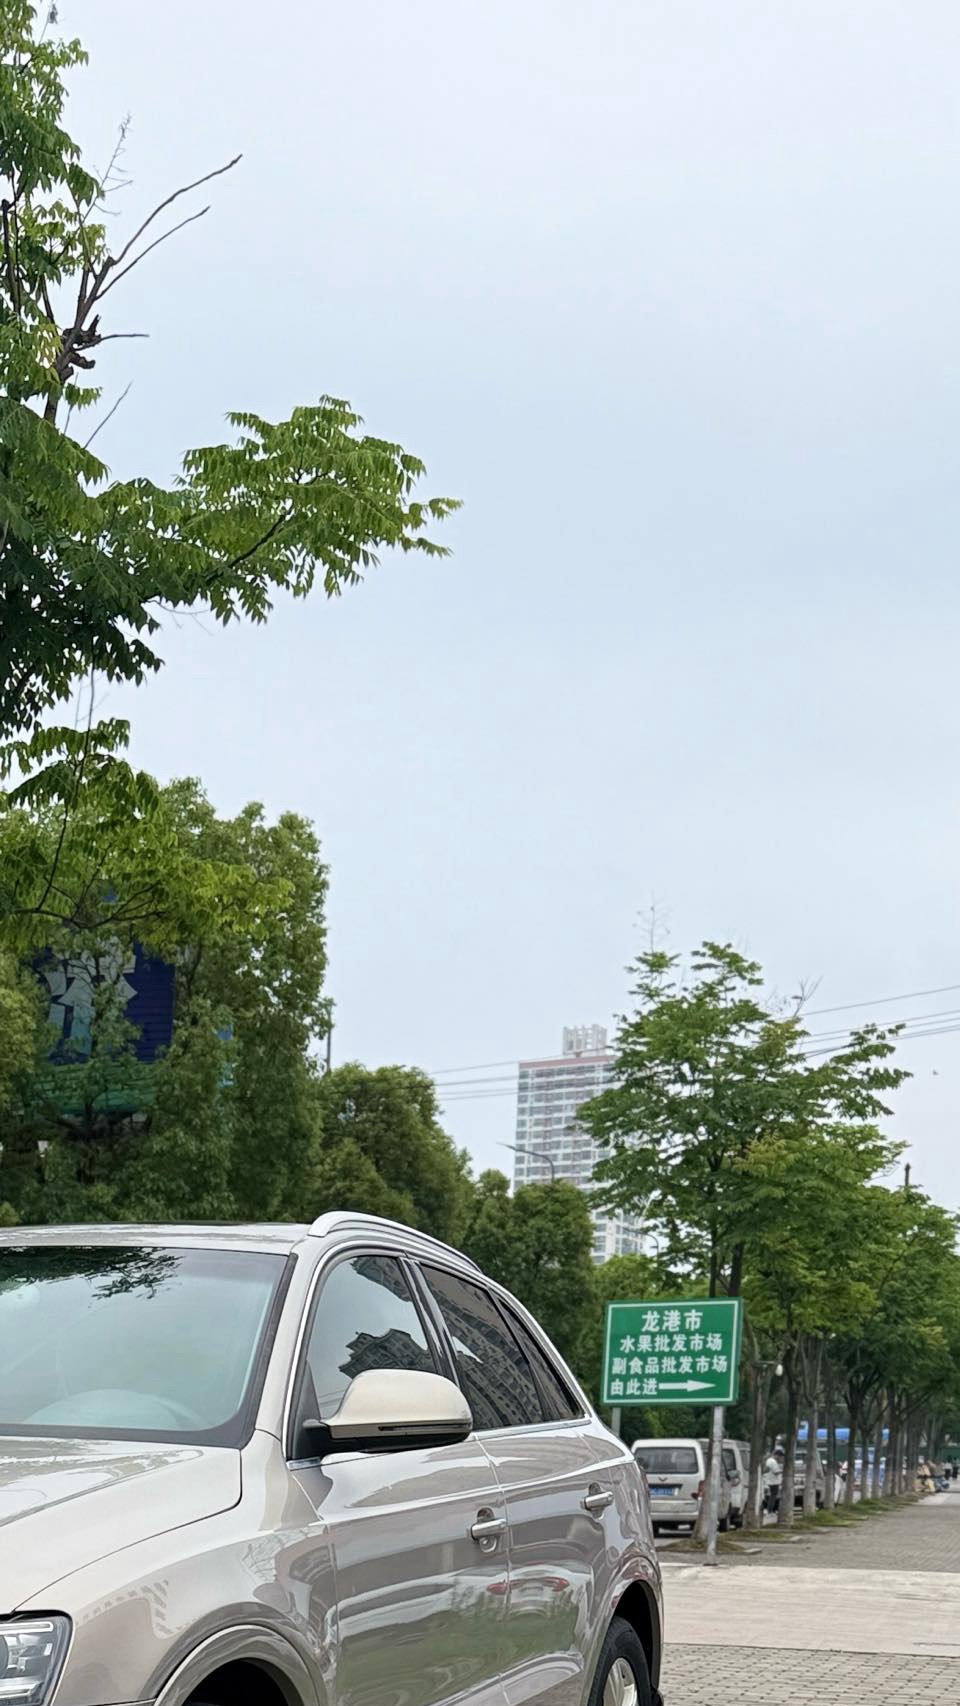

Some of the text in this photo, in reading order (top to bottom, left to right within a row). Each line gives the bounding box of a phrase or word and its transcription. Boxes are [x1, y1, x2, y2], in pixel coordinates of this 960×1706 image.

[641, 1309, 703, 1332] 龙港市
[620, 1333, 723, 1353] 水果批发市场
[611, 1355, 729, 1375] 副食品批发市场
[610, 1378, 658, 1396] 由此进
